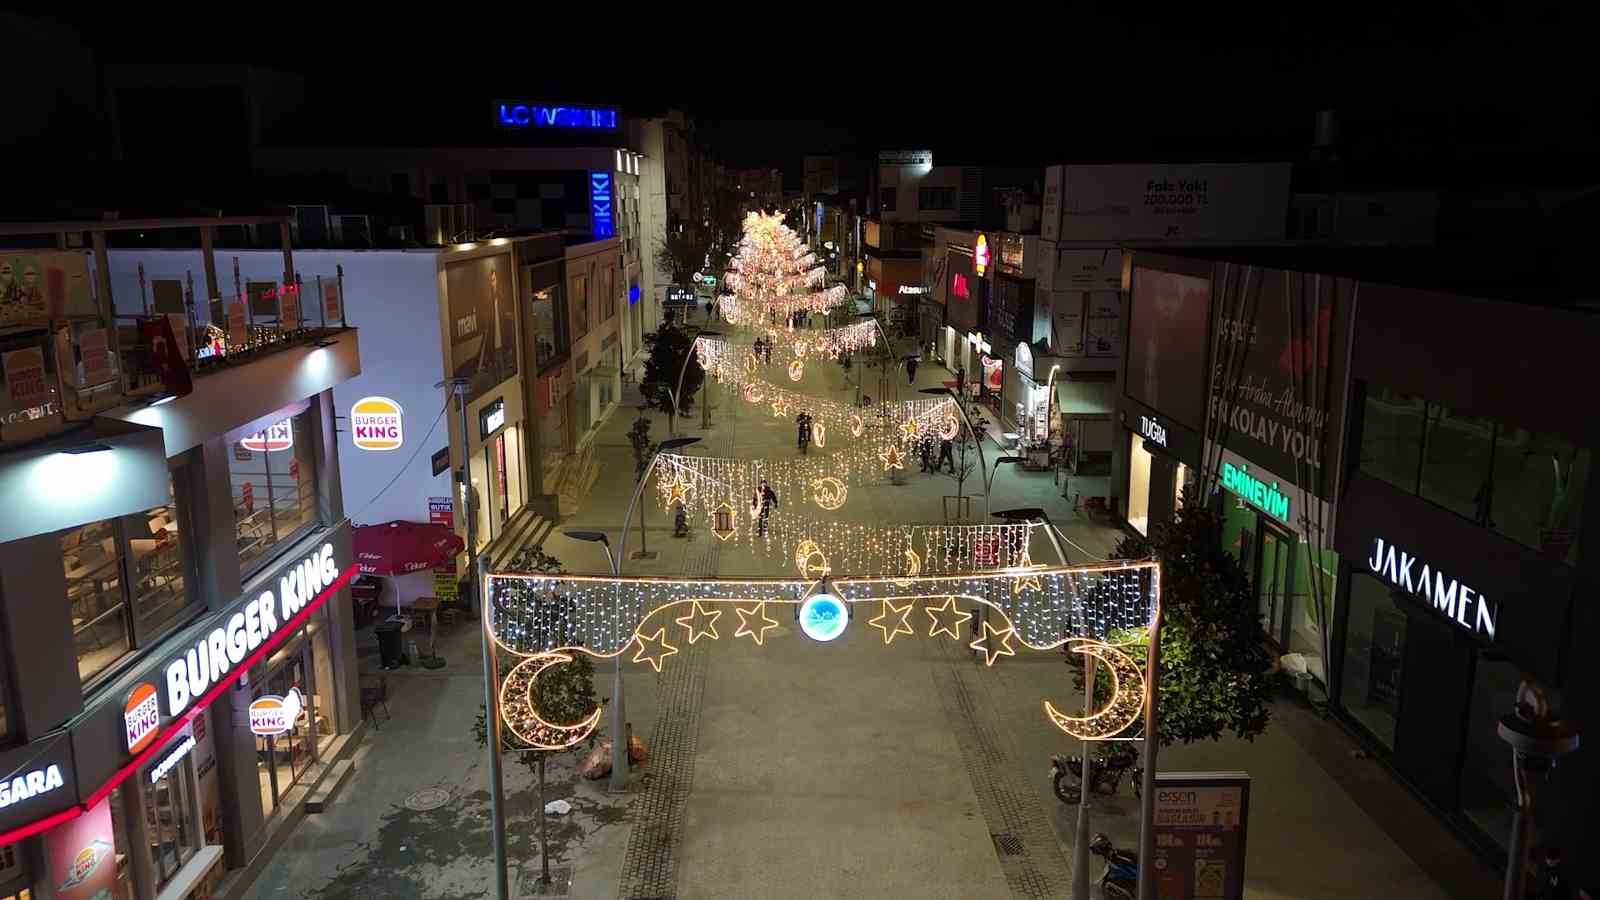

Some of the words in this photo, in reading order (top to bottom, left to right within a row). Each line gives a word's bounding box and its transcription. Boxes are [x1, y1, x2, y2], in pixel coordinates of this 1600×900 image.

[355, 416, 398, 426] BURGER
[356, 426, 398, 438] KING
[1230, 405, 1279, 446] KOLAY
[1369, 537, 1498, 641] JAKAMEN
[166, 590, 278, 717] BURGER
[127, 697, 156, 728] BURGER
[129, 710, 158, 743] KING
[252, 717, 285, 727] KING
